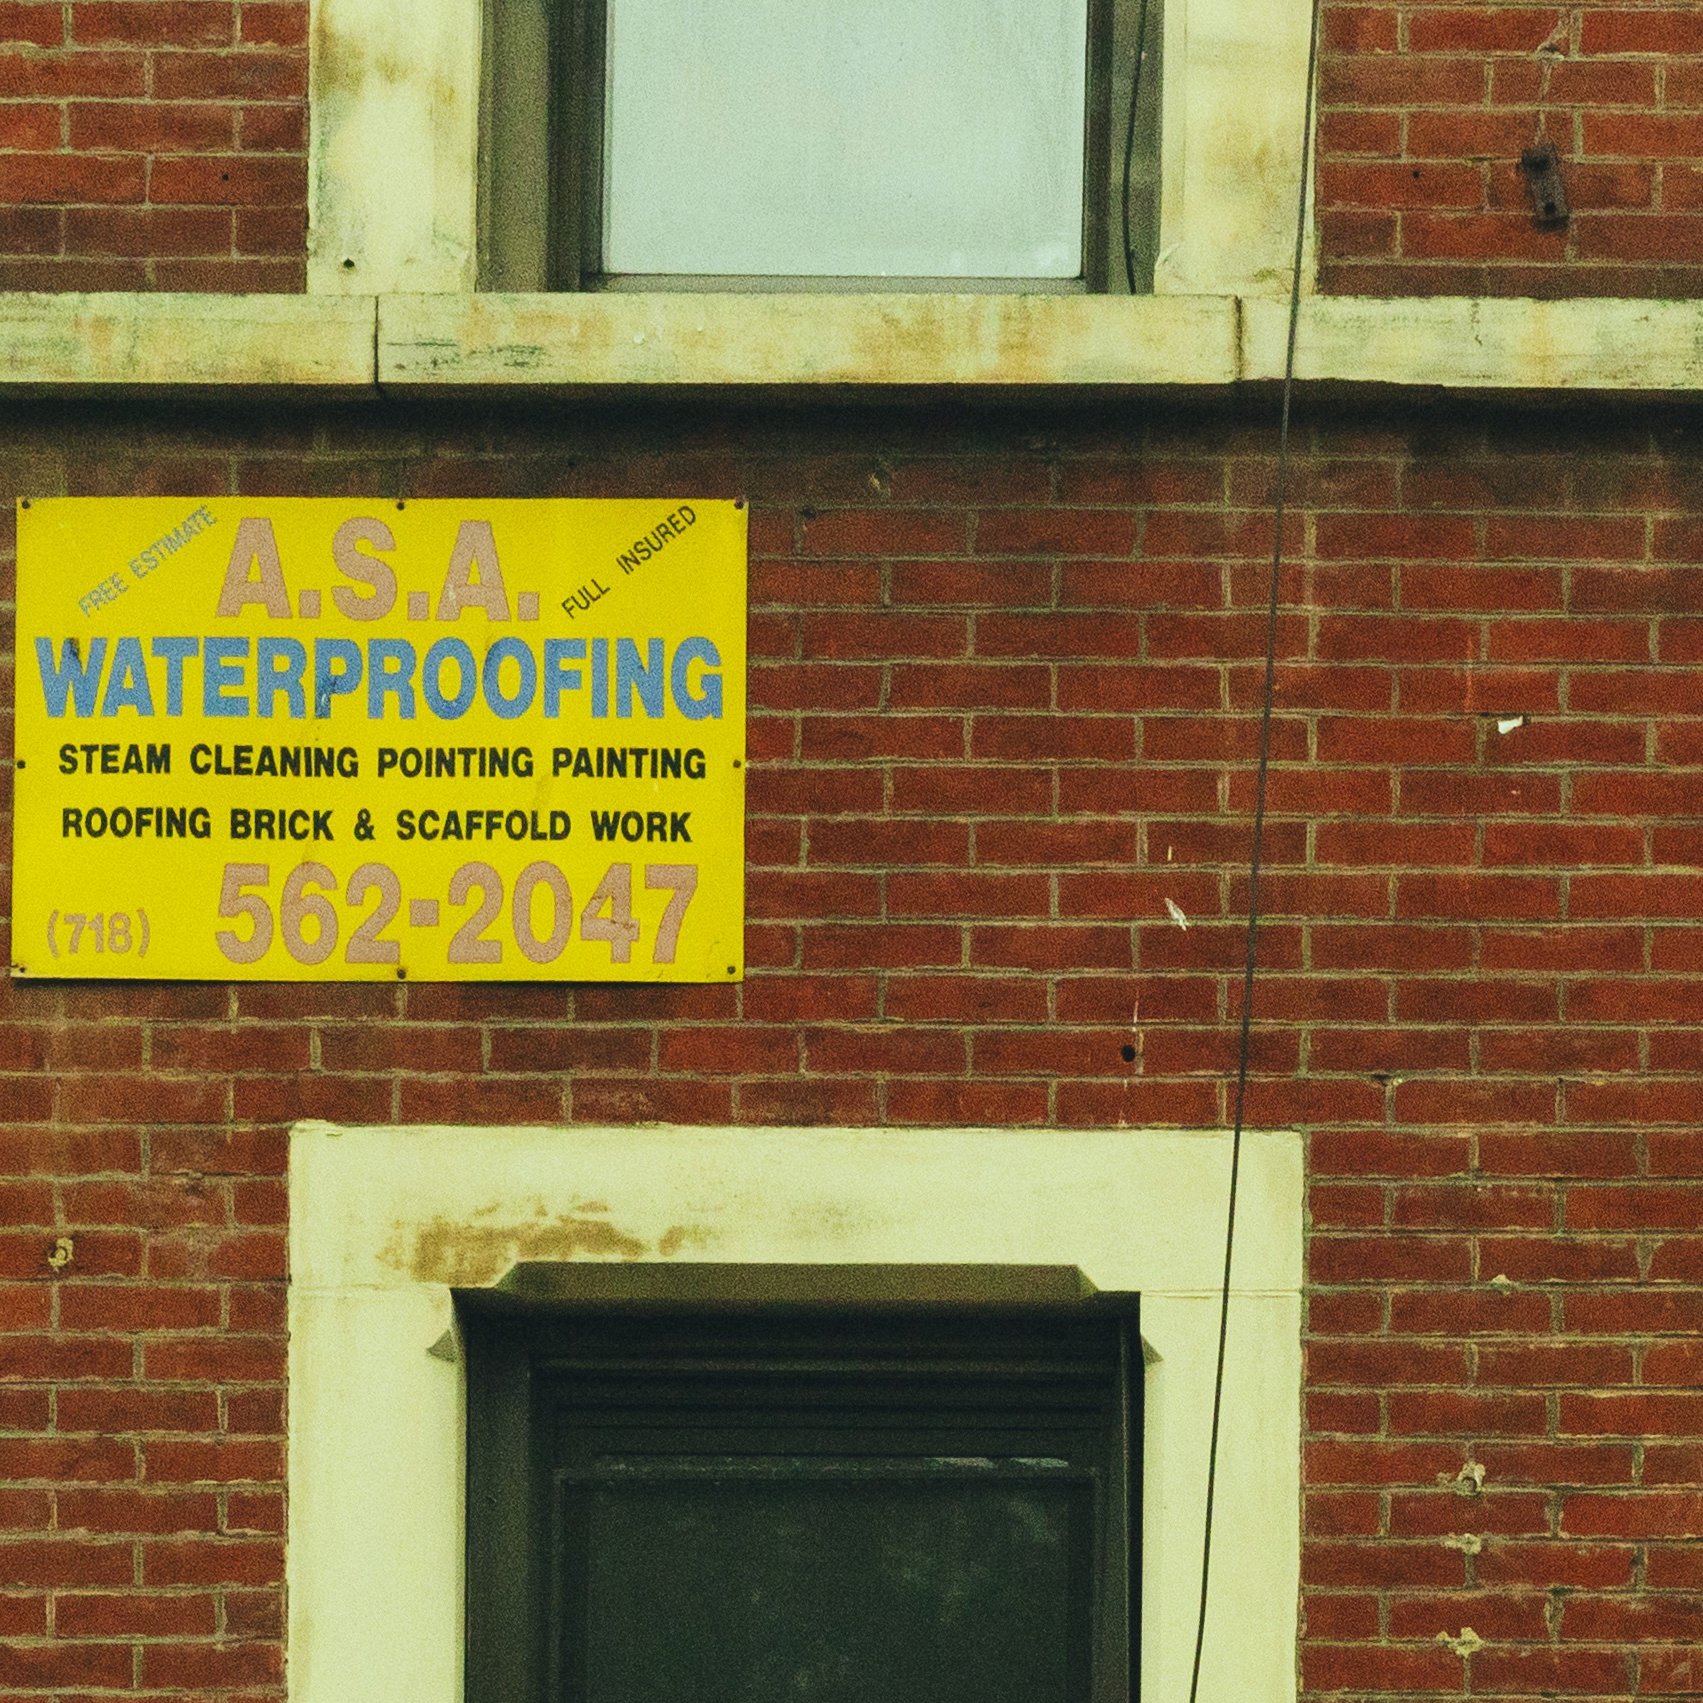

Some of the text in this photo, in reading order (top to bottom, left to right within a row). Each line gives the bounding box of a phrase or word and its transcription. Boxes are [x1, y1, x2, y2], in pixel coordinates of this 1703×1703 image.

[77, 504, 217, 617] FREE ESTIMATE
[215, 516, 540, 622] A.S.A.
[561, 505, 698, 620] FULL INSURED
[34, 635, 724, 721] WATERPROOFING
[58, 742, 707, 780] STEAM CLEANING POINTING PAINTING
[62, 806, 694, 843] ROOFING BRICK & SCAFFOLD WORK
[46, 860, 699, 966] (718) 562-2047
